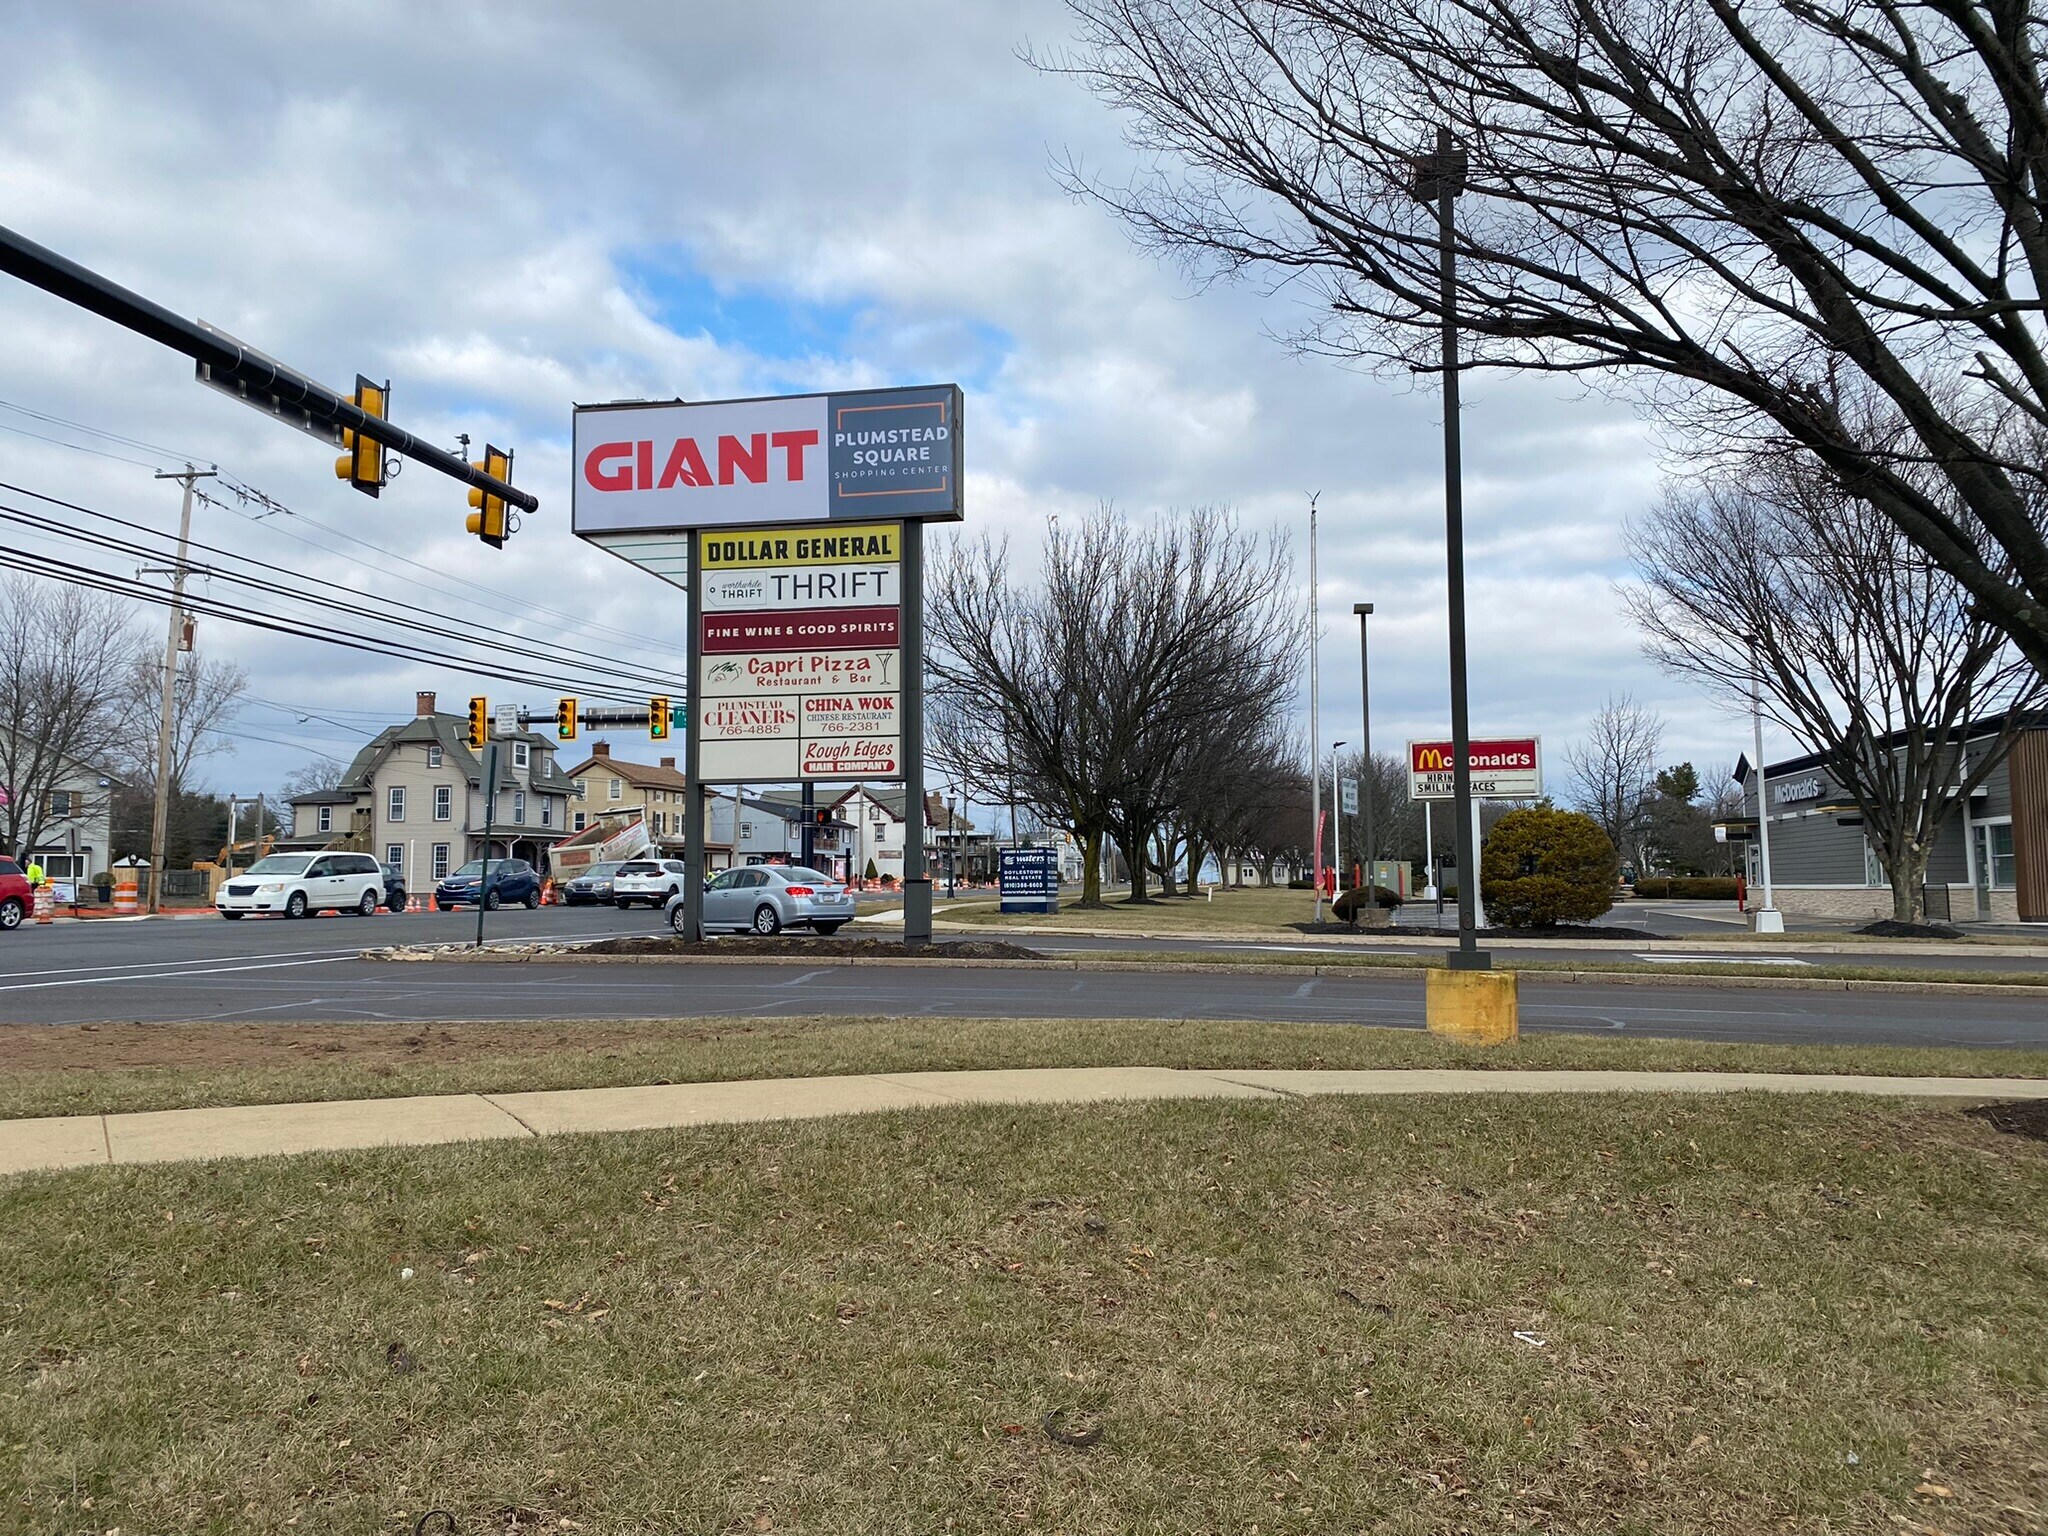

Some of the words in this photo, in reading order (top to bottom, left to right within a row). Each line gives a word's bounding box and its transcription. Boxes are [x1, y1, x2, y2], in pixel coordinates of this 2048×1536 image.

[835, 426, 949, 447] PLUMSTEAD
[584, 429, 818, 492] GIANT
[853, 447, 930, 466] SQUARE
[834, 469, 896, 479] SHOPPING
[902, 465, 949, 475] CENTER
[708, 540, 788, 562] DOLLAR
[796, 535, 892, 559] GENERAL
[721, 580, 762, 589] worthwhile
[770, 571, 889, 600] THRIFT
[721, 588, 762, 599] THRIFT
[708, 628, 740, 638] FINE
[745, 626, 781, 636] WINE
[786, 626, 794, 635] &
[798, 624, 836, 635] GOOD
[841, 622, 895, 633] SPIRITS
[747, 656, 803, 677] Capri
[811, 656, 871, 672] Pizza
[756, 675, 822, 687] Restaurant
[832, 674, 839, 683] &
[850, 673, 872, 683] Bar
[717, 700, 783, 711] PLUMSTEAD
[805, 698, 854, 712] CHINA
[858, 697, 894, 710] WOK
[704, 709, 796, 727] CLEANERS
[806, 713, 841, 722] CHINESE
[841, 712, 892, 721] RESTAURANT
[718, 725, 781, 735] 766-4885
[821, 722, 880, 732] 766-2381
[805, 741, 850, 760] Rough
[854, 740, 893, 758] Edges
[808, 762, 834, 772] HAIR
[837, 761, 890, 772] COMPANY
[1418, 749, 1531, 769] Mconald's
[1427, 773, 1454, 782] HIRIN
